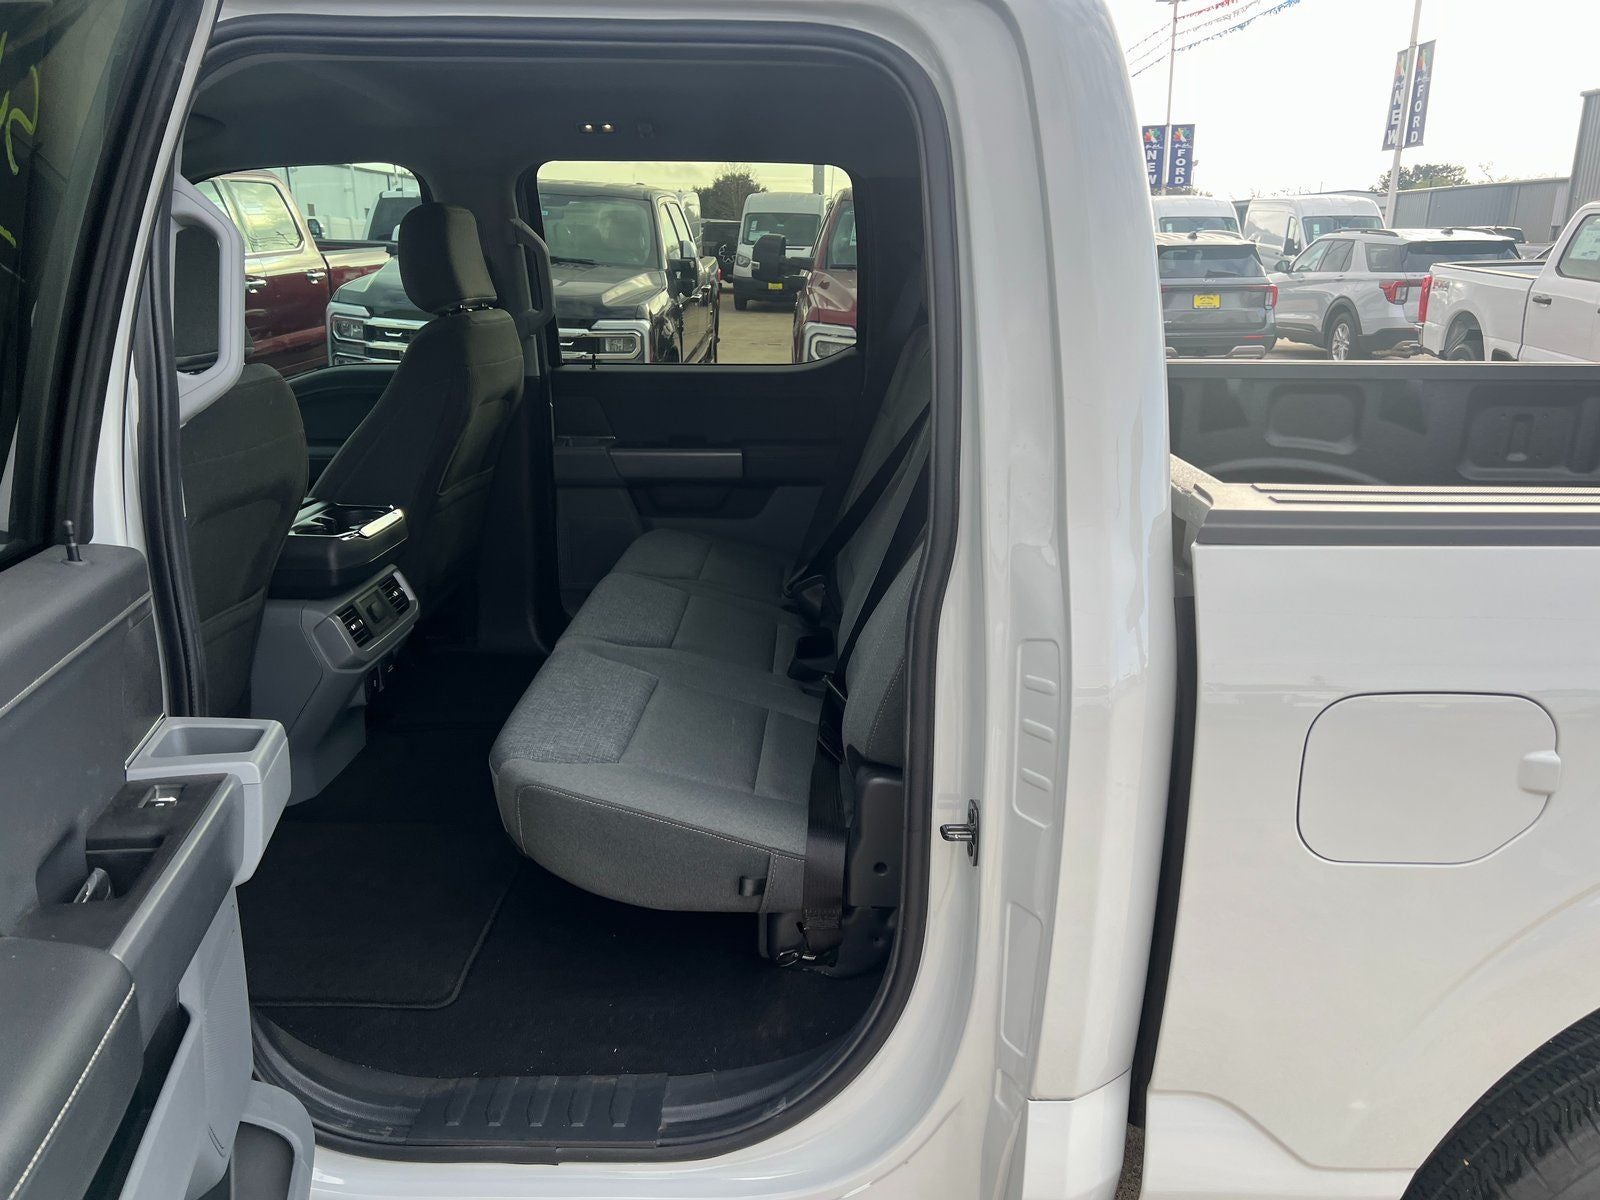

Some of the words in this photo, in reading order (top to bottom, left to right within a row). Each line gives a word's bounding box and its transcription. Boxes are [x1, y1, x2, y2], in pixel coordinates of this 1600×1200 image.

[1387, 90, 1403, 145] NEW
[1410, 85, 1424, 143] FORD
[1174, 149, 1186, 184] FORD
